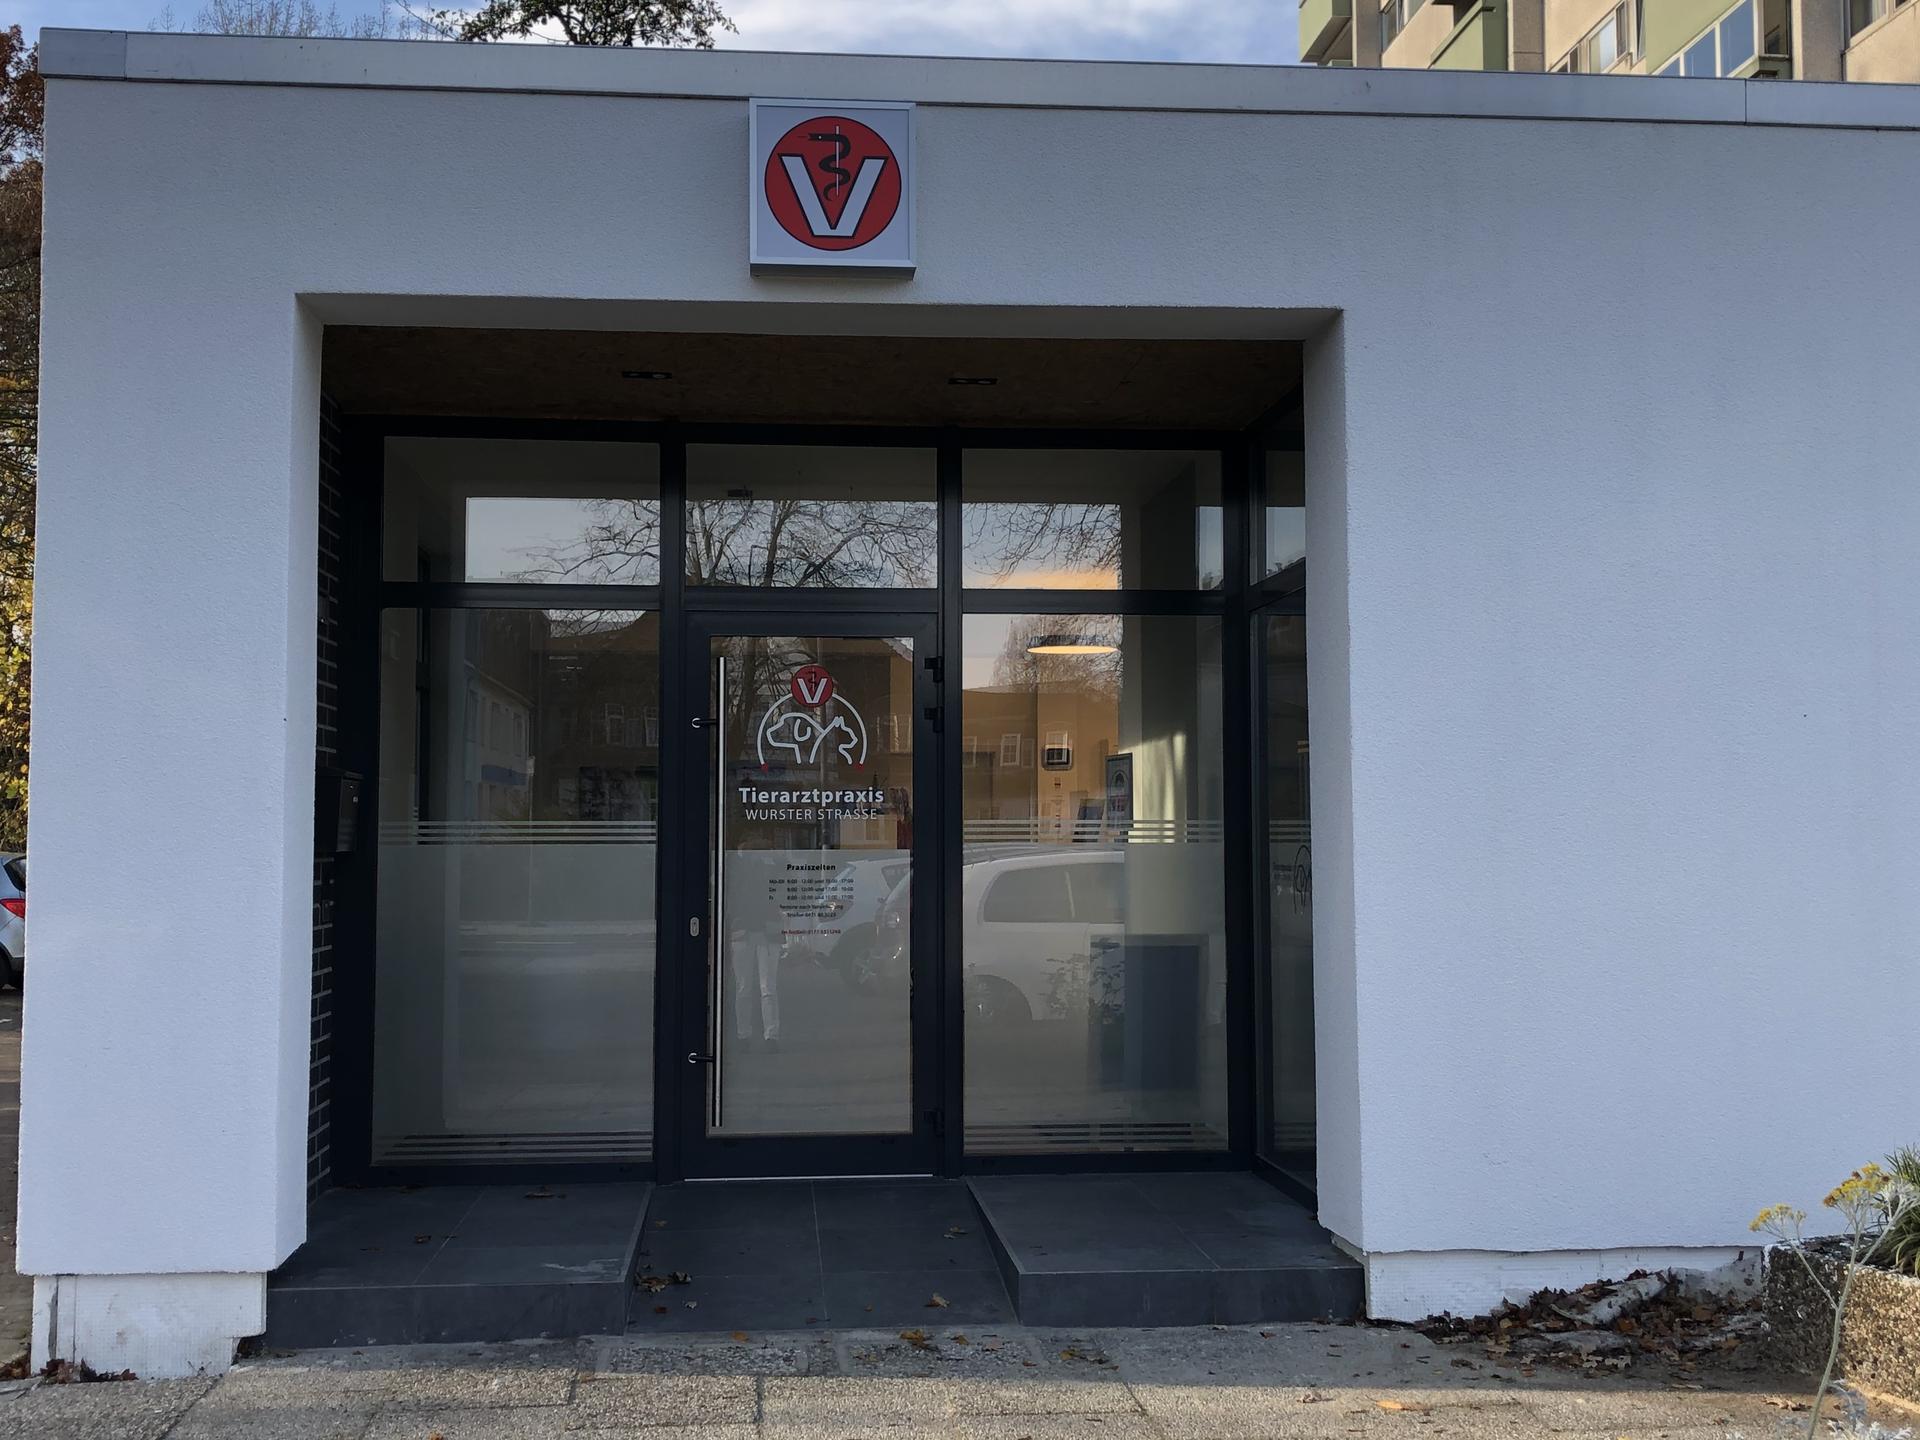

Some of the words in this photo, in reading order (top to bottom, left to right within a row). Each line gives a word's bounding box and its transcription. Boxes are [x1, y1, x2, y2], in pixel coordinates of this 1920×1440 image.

[738, 787, 885, 806] Tierarztpraxis
[745, 808, 813, 820] WURSTER
[817, 808, 878, 820] STRASSE
